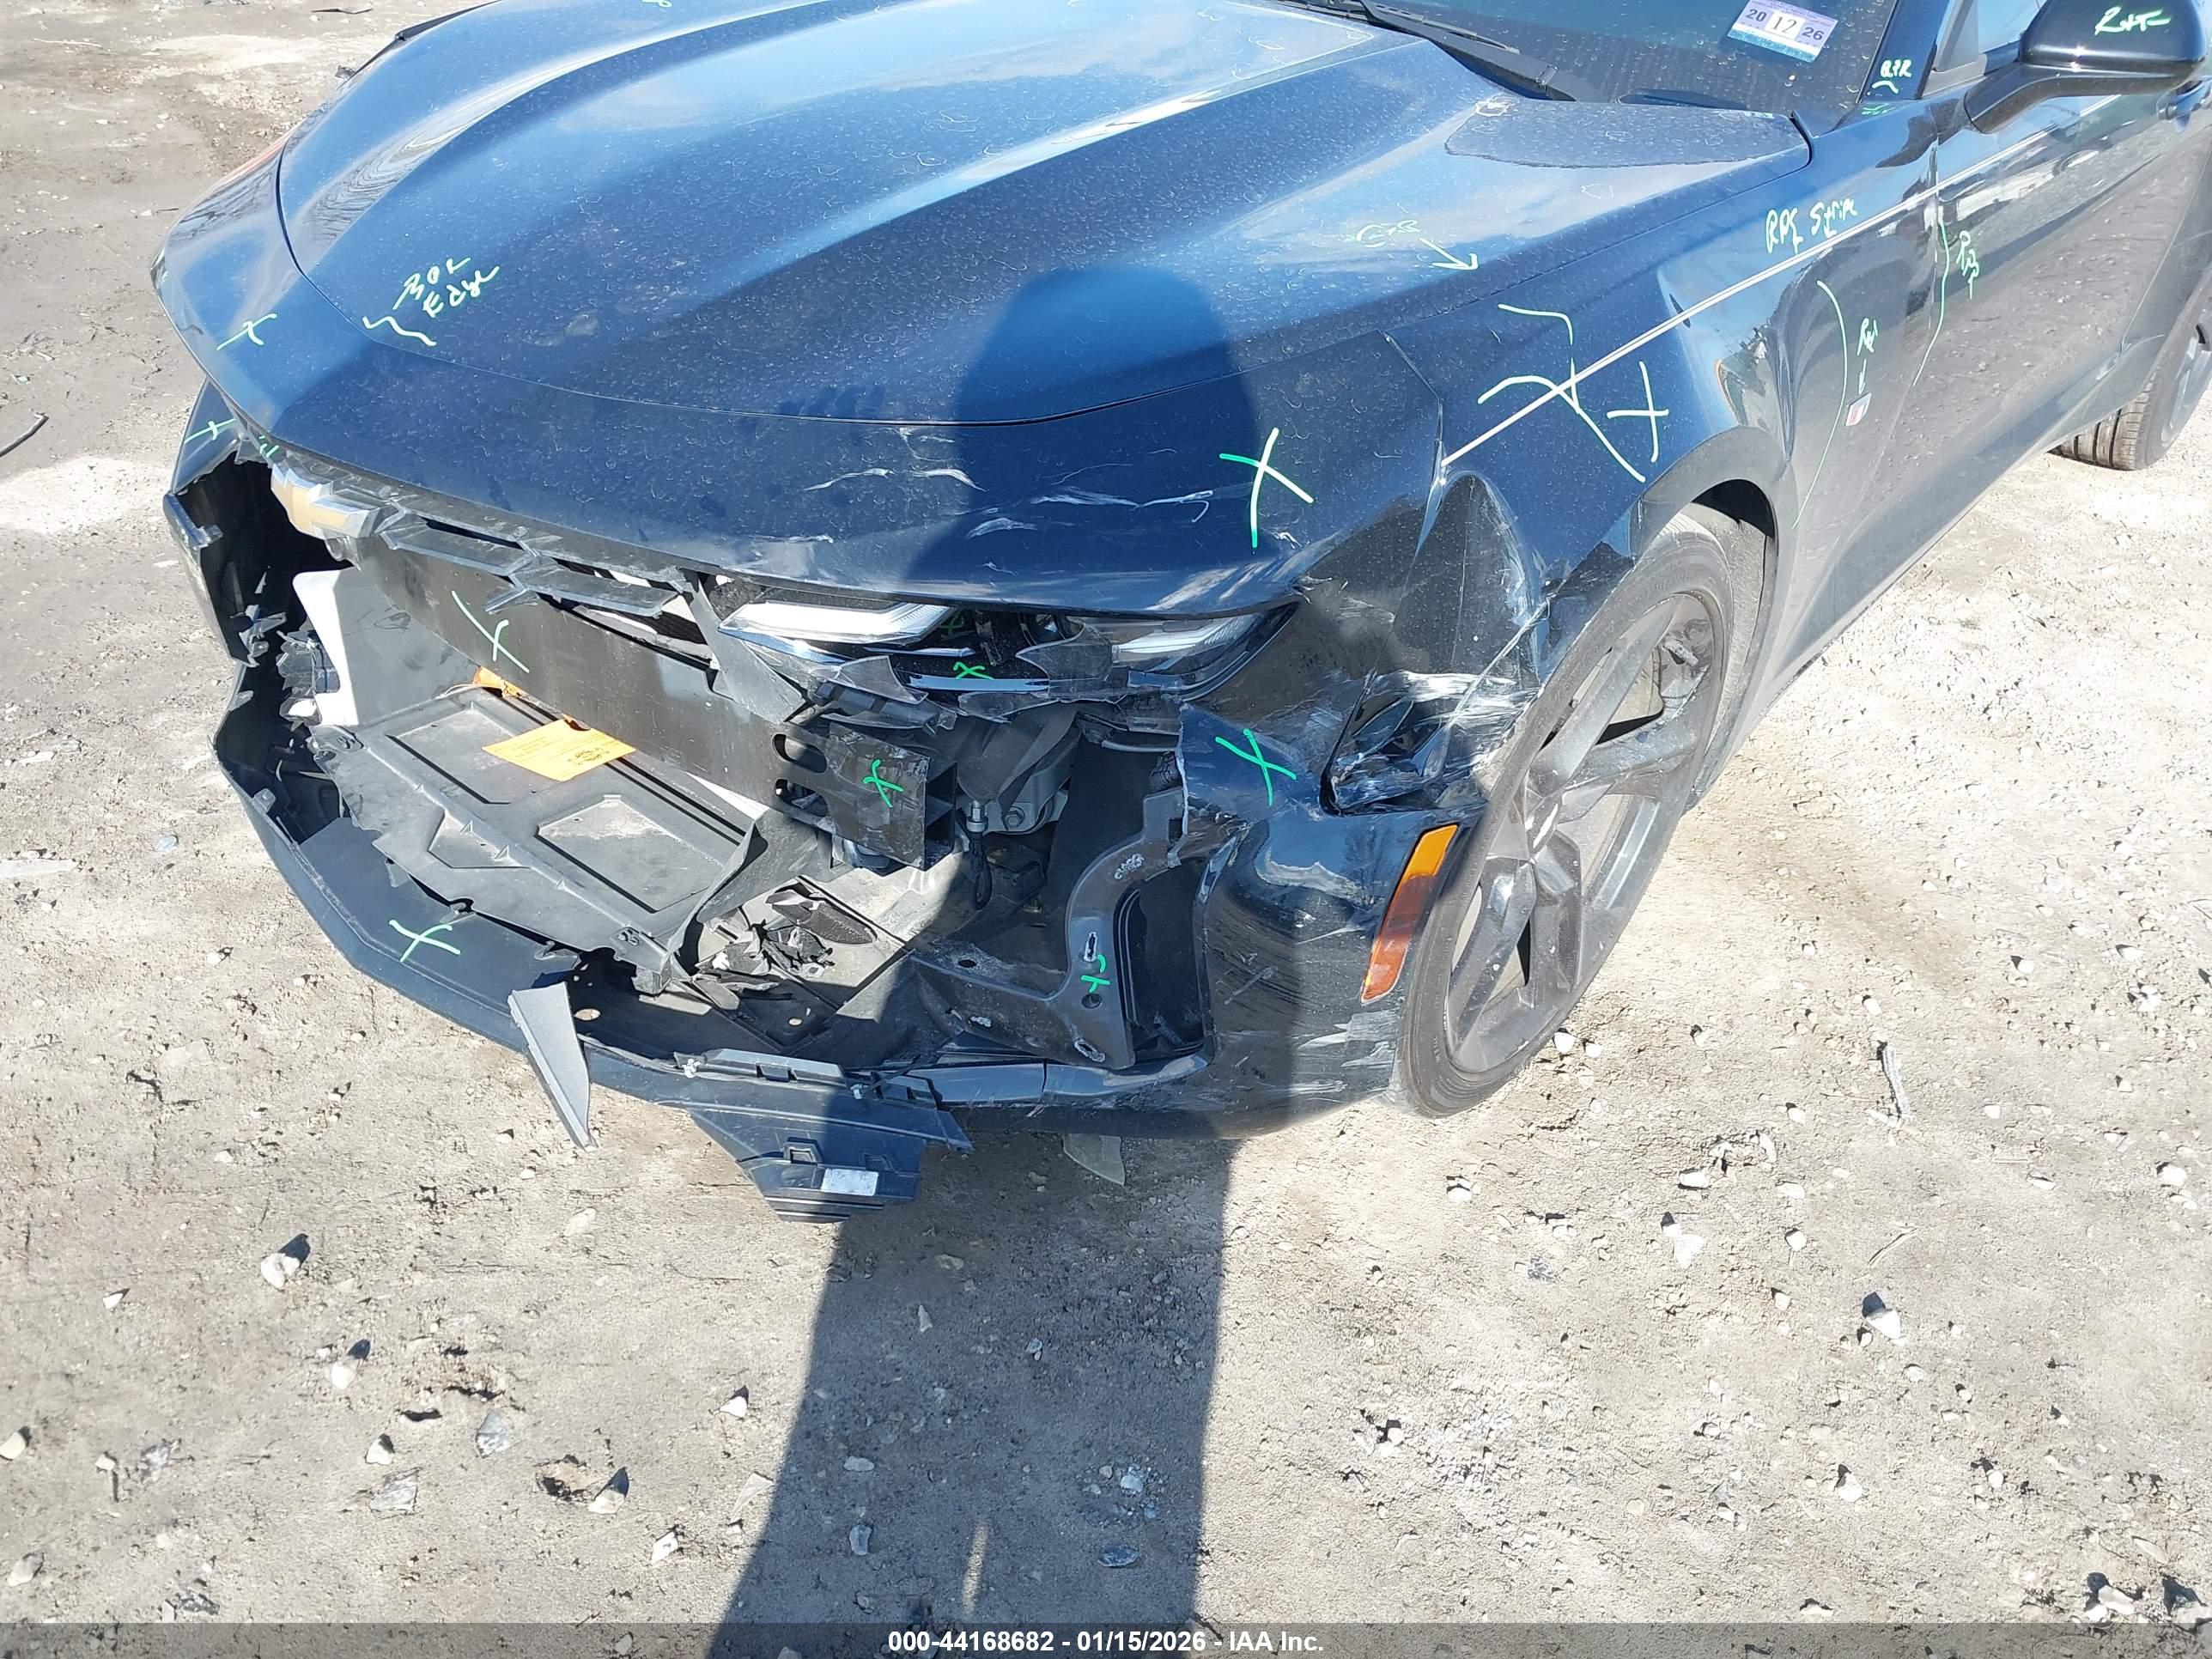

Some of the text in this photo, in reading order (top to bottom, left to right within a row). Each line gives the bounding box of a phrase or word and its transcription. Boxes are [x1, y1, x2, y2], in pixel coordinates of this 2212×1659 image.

[1746, 9, 1767, 22] 20
[1771, 16, 1797, 33] 12
[1802, 27, 1825, 40] 26
